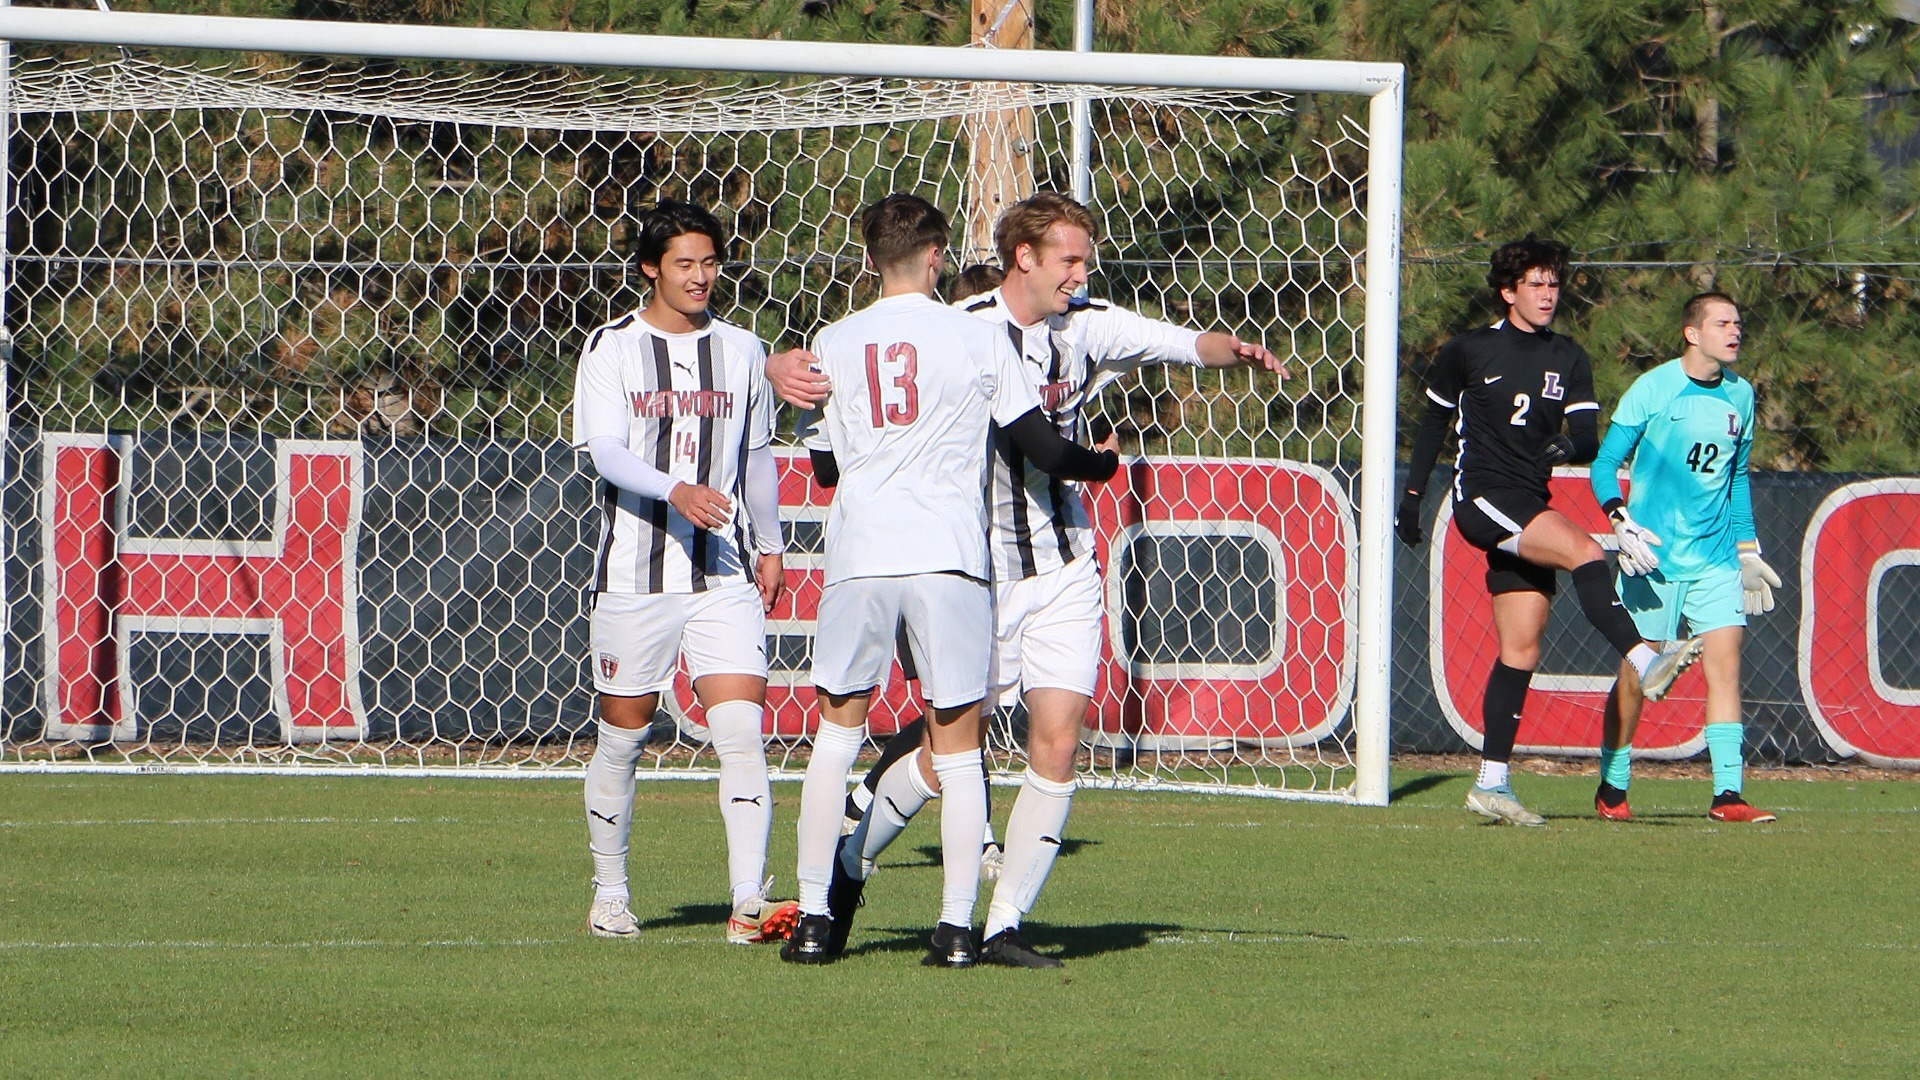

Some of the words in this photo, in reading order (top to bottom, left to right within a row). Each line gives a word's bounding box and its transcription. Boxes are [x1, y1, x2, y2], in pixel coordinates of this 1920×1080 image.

[865, 341, 919, 428] 13
[1541, 371, 1565, 401] L
[1510, 393, 1531, 426] 2
[1726, 412, 1740, 437] L
[675, 431, 697, 464] 14
[1686, 442, 1719, 474] 42
